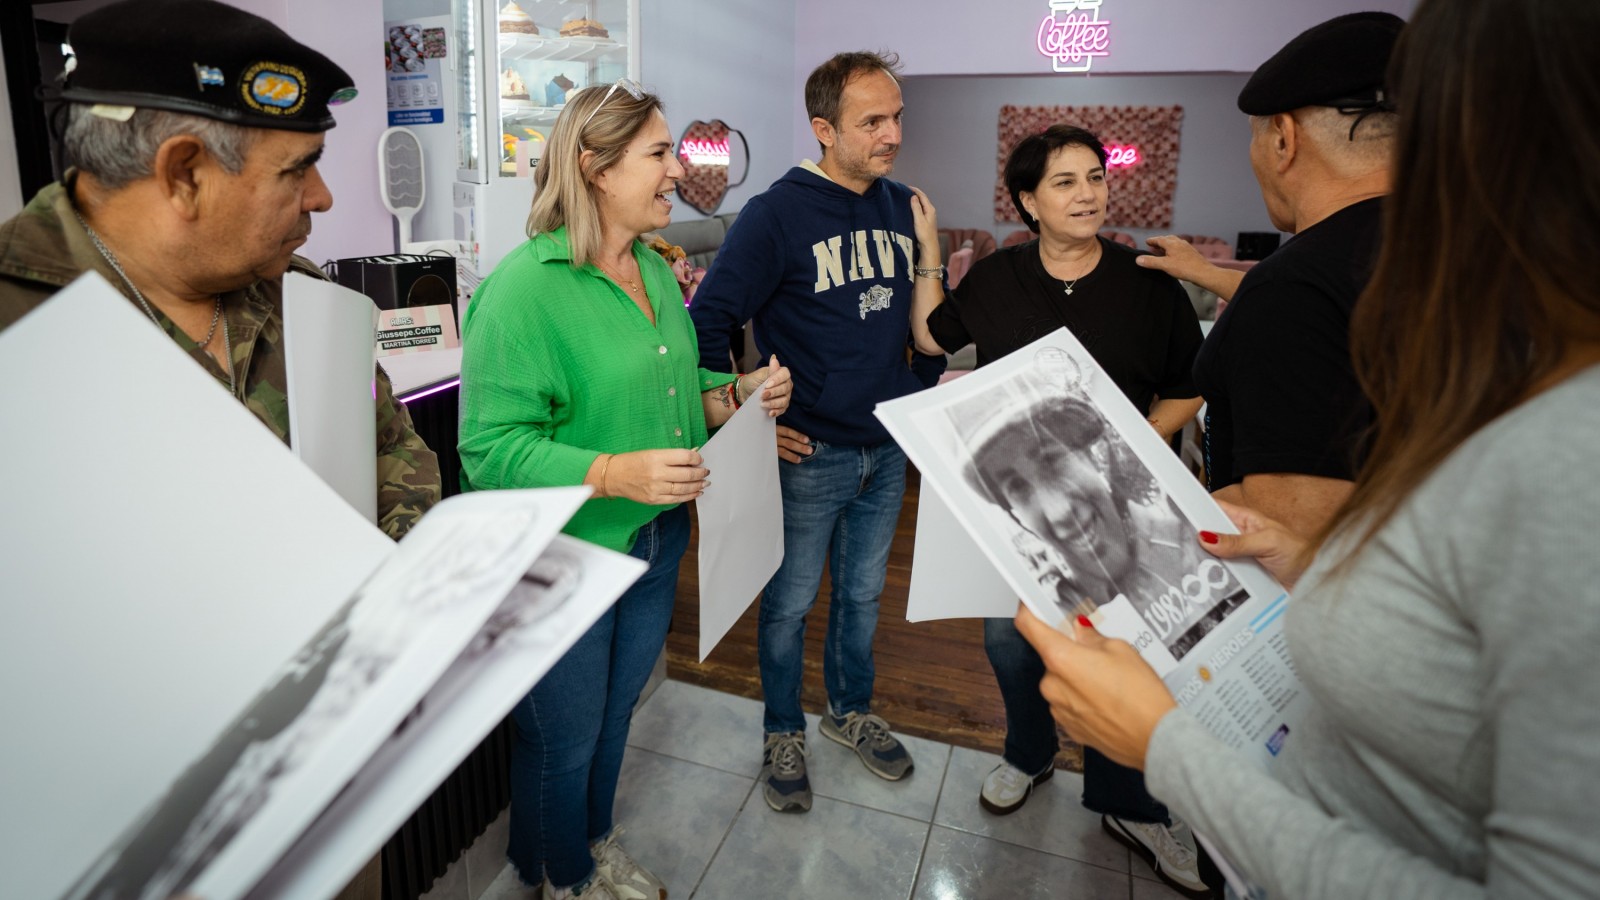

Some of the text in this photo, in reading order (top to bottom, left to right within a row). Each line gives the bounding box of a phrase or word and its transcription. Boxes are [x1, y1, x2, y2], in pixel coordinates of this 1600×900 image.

[1037, 13, 1110, 62] Coffee
[812, 229, 914, 293] NAVY
[376, 327, 441, 340] Giussepe.Coffee
[384, 340, 412, 349] MARTINA
